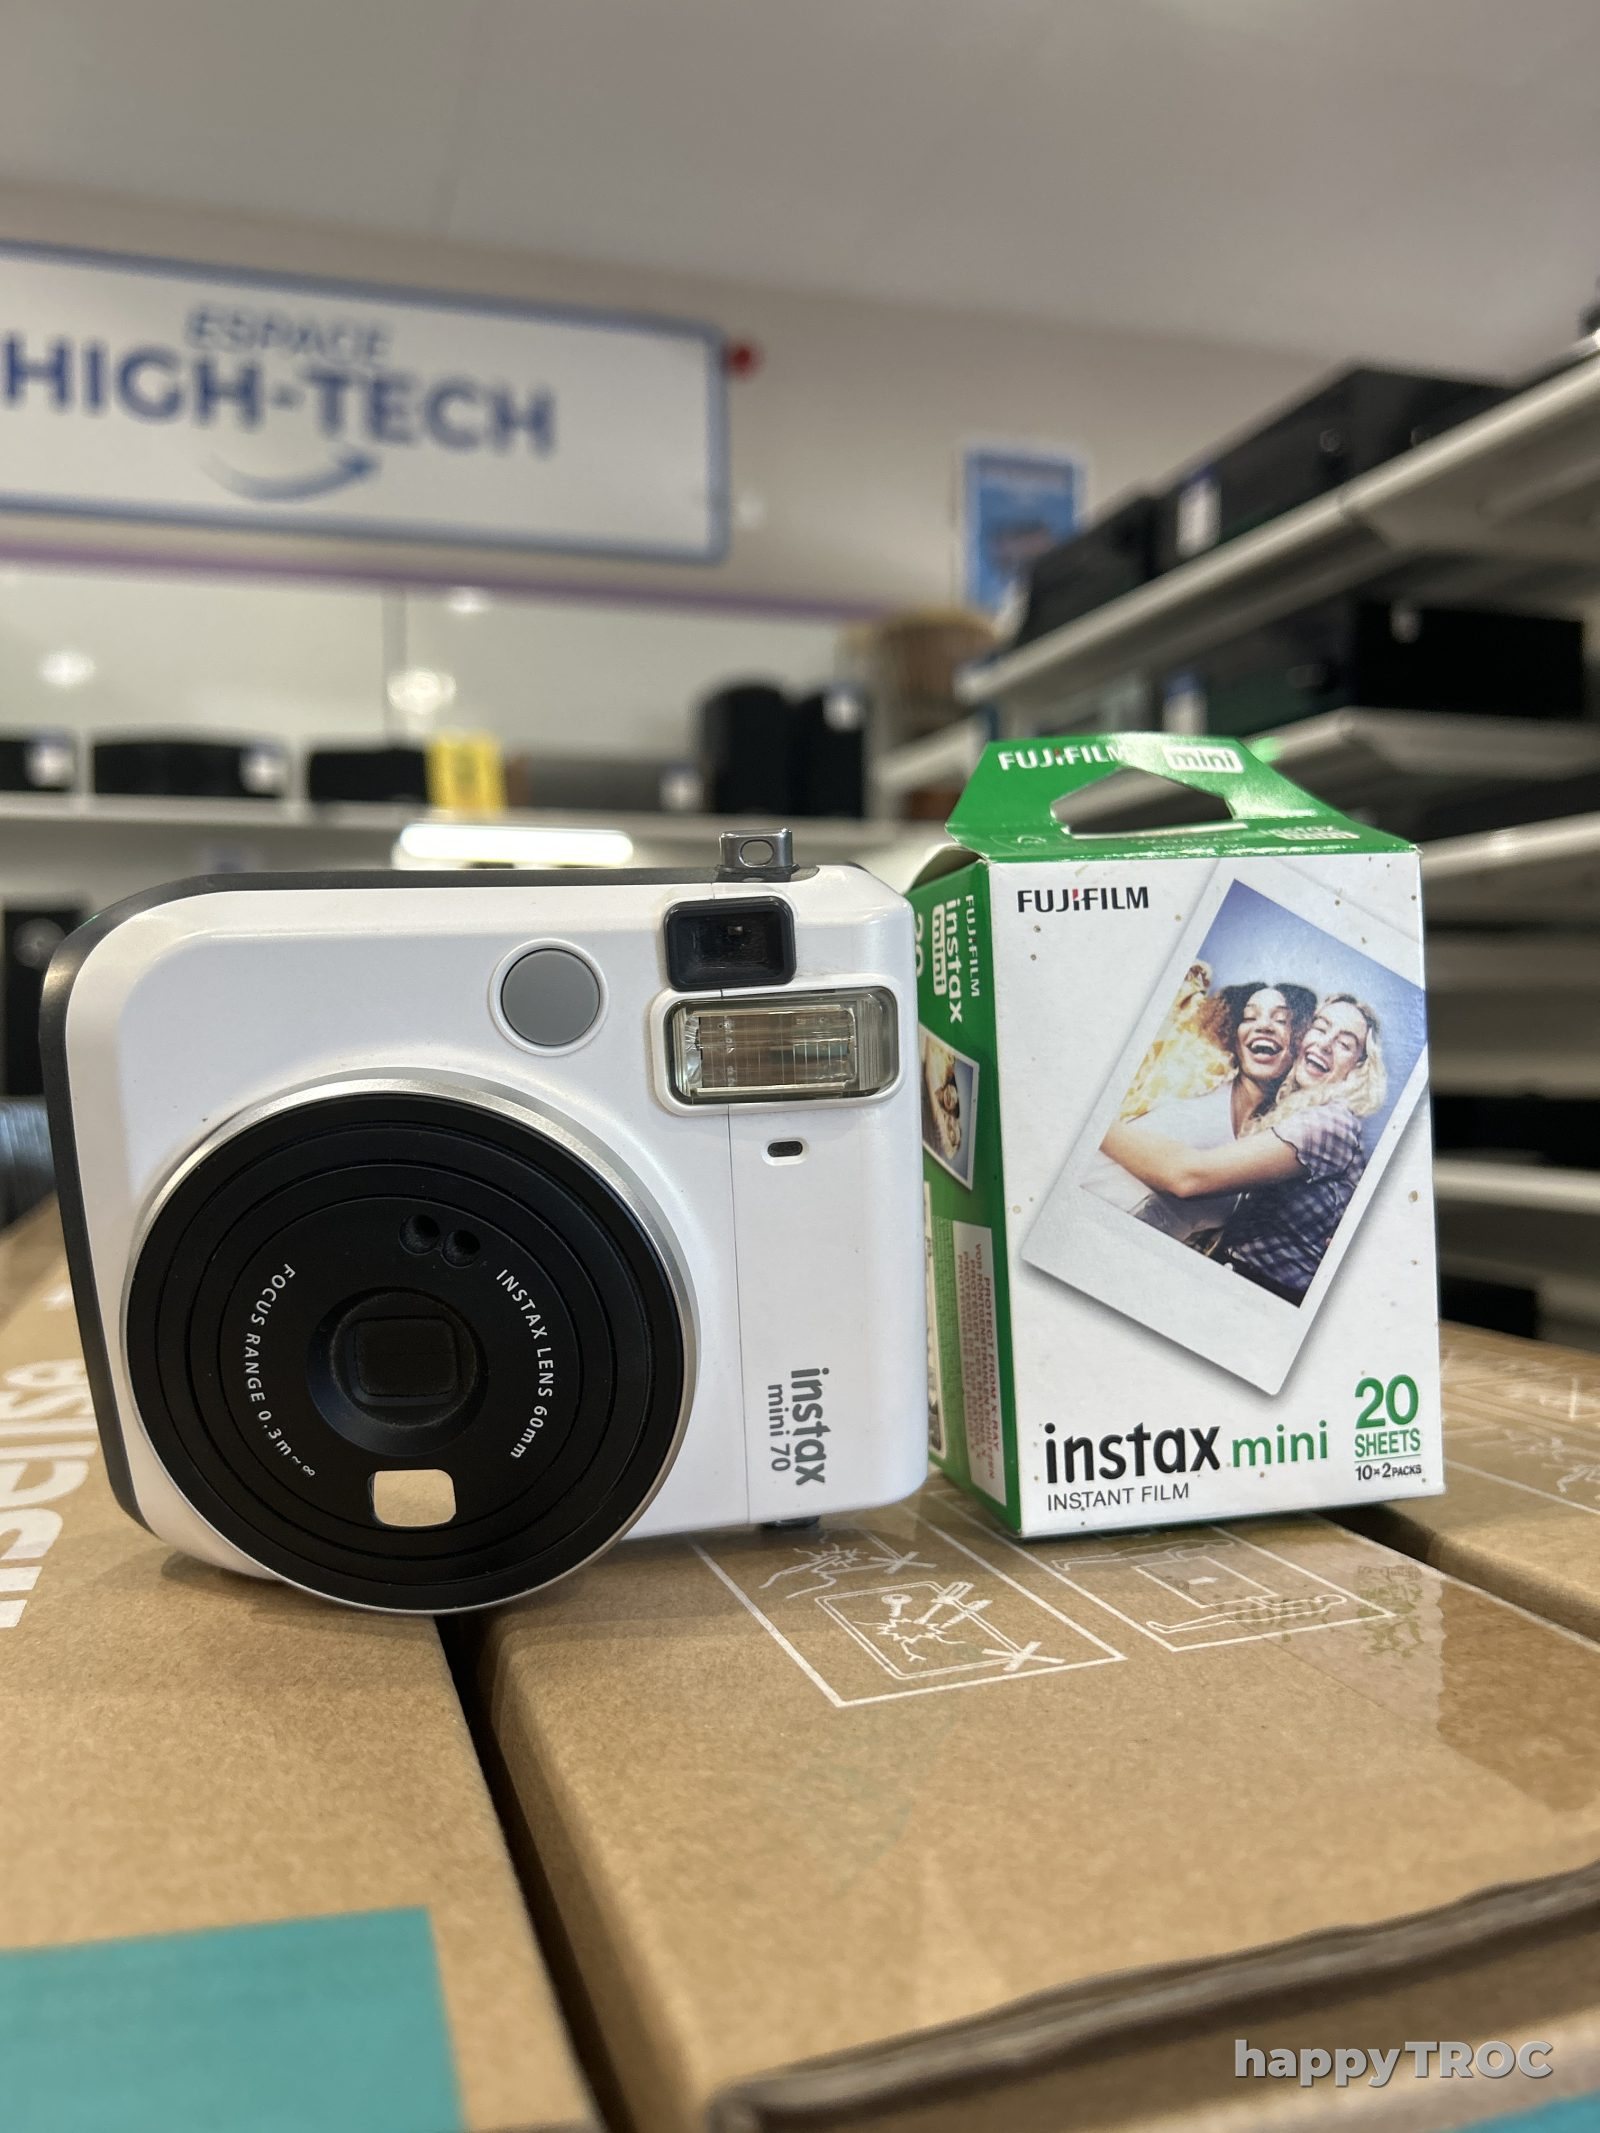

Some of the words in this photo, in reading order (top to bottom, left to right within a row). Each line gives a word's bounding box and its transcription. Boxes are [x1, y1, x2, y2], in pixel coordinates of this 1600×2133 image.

[190, 305, 390, 355] ESPACE
[2, 331, 558, 457] HIGH-TECH
[1017, 886, 1149, 913] FUJIFILM
[933, 913, 946, 987] mini
[946, 898, 963, 1023] instax
[965, 895, 980, 997] FUJIFILM
[250, 1263, 296, 1326] FOCUS
[496, 1269, 548, 1340] INSTAX
[984, 1277, 994, 1349] PROTECT
[244, 1332, 266, 1402] RANGE
[536, 1347, 554, 1397] LENS
[988, 1352, 997, 1399] FROM
[510, 1405, 548, 1458] 60mm
[767, 1383, 791, 1437] mini
[790, 1367, 831, 1486] instax
[1353, 1374, 1419, 1430] 20
[770, 1443, 791, 1471] 70
[1044, 1422, 1221, 1484] instax
[1232, 1420, 1328, 1468] mini
[1353, 1428, 1422, 1459] SHEETS
[1046, 1487, 1135, 1512] INSTANT
[1141, 1482, 1190, 1503] FILM
